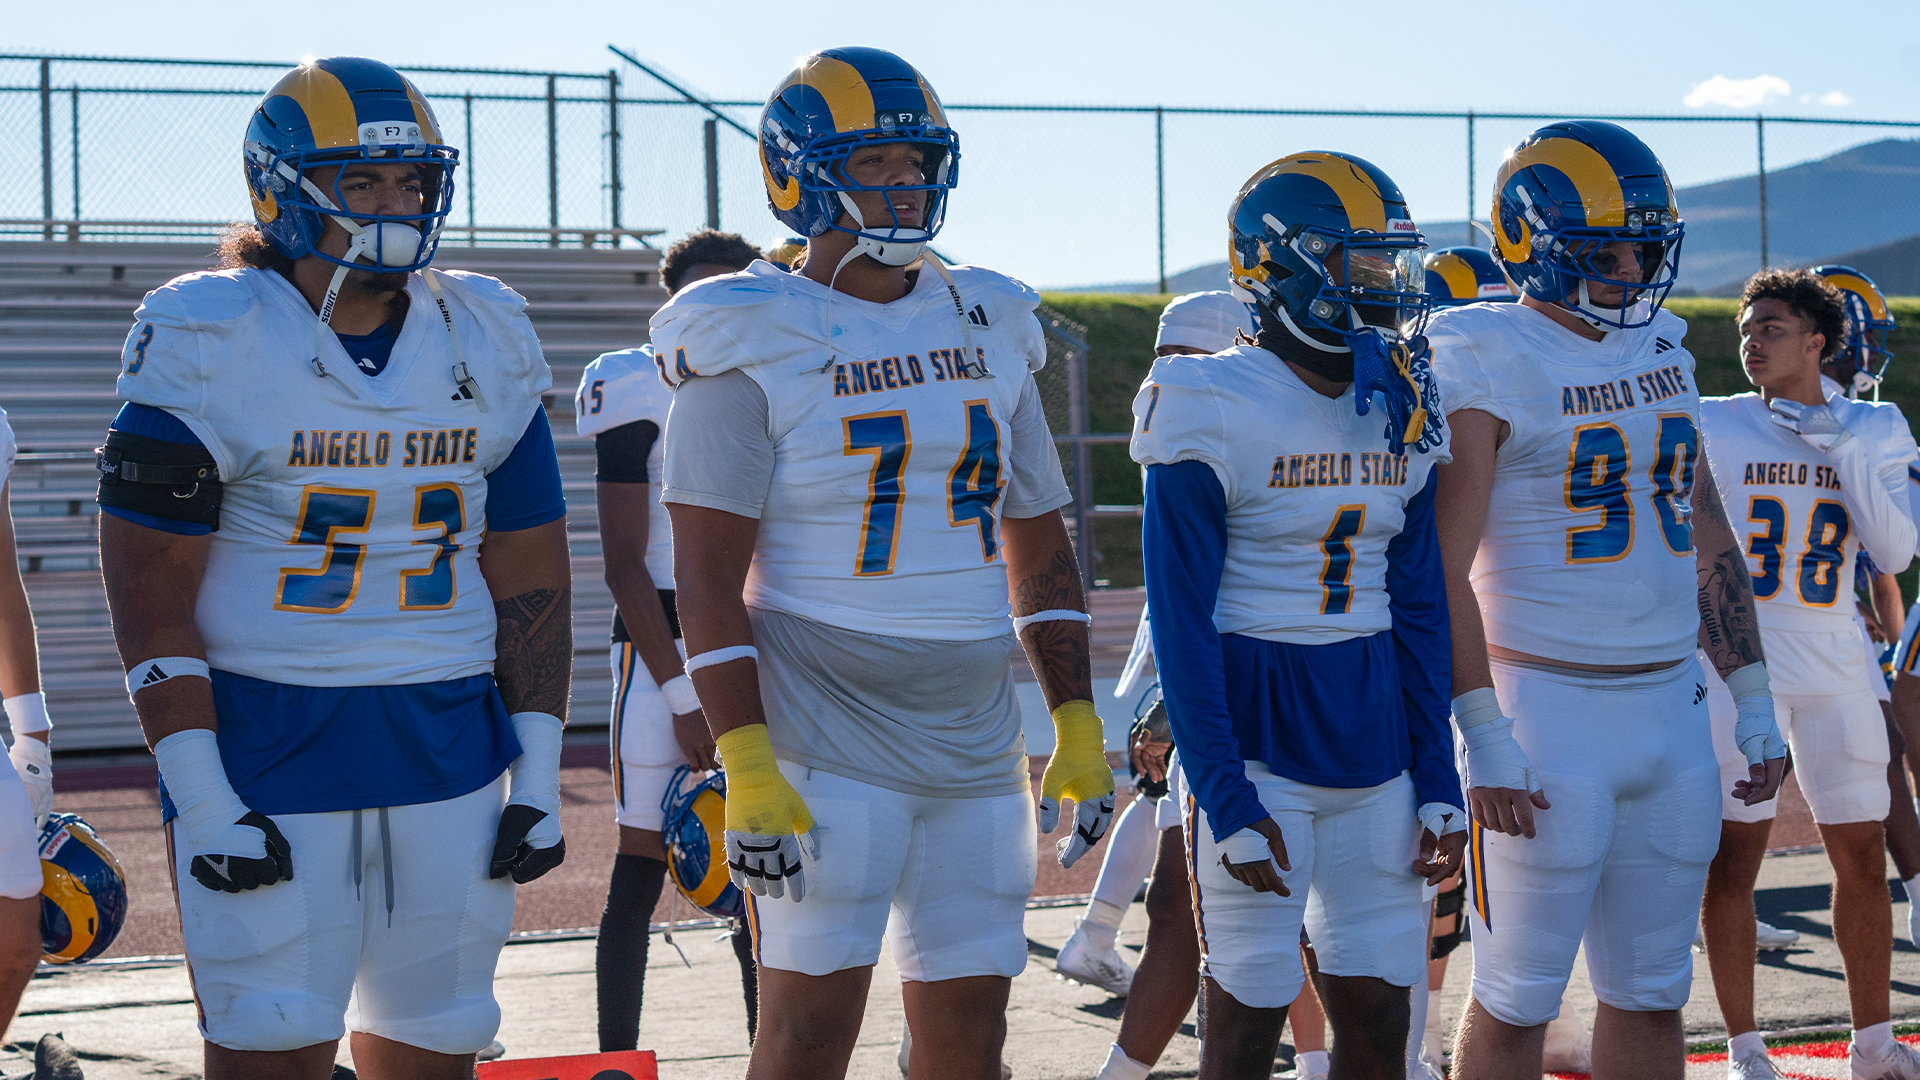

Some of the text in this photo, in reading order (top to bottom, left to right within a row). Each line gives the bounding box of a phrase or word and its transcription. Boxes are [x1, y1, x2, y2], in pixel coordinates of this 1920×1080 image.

[385, 126, 400, 136] F7
[899, 113, 912, 122] F7
[1646, 212, 1657, 220] F7
[125, 322, 155, 376] 3
[834, 354, 925, 398] ANGELO
[1562, 365, 1688, 416] ANGELO STATE
[287, 428, 478, 468] ANGELO STATE
[1268, 452, 1408, 488] ANGELO STATE
[841, 398, 1007, 576] 74
[1564, 412, 1700, 564] 90
[1743, 462, 1808, 486] ANGELO
[272, 482, 466, 614] 53
[1318, 504, 1366, 614] 1
[1746, 494, 1851, 608] 38
